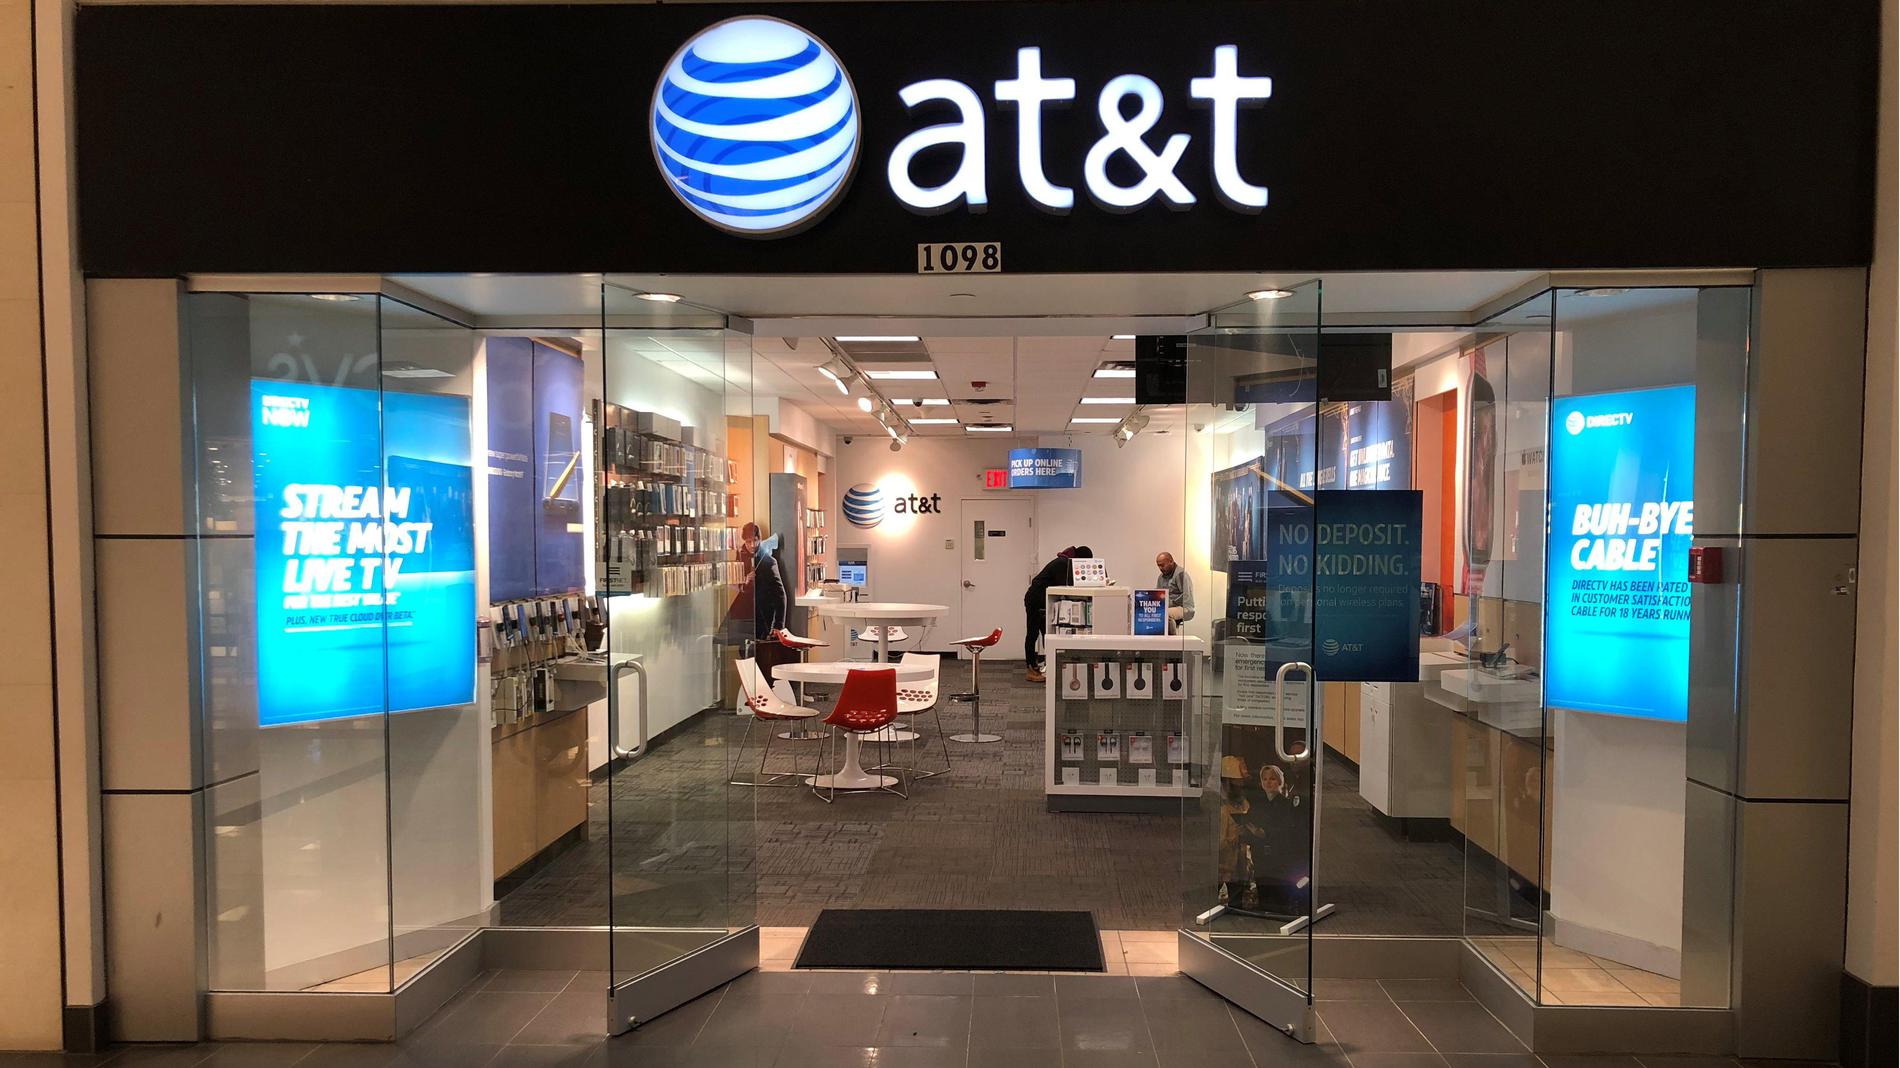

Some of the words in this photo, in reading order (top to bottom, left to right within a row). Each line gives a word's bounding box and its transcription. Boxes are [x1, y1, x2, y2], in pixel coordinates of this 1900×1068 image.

[887, 44, 1272, 210] at&t
[923, 245, 999, 271] 1098
[262, 407, 310, 428] NOW
[1586, 413, 1633, 428] DIRECTV
[1011, 460, 1022, 468] PICK
[1023, 459, 1034, 467] UP
[1034, 459, 1063, 468] ONLINE
[1011, 468, 1034, 477] ORDERS
[1035, 468, 1057, 476] HERE
[986, 469, 1008, 489] EXIT
[280, 483, 411, 518] STREAM
[894, 493, 942, 514] at&t
[281, 521, 345, 556] THE
[347, 521, 433, 555] MOST
[1279, 524, 1309, 545] NO
[1317, 523, 1410, 545] DEPOSIT.
[1571, 538, 1661, 571] CABLE
[283, 558, 355, 593] LIVE
[360, 557, 403, 590] TV
[1279, 554, 1308, 575] NO
[1317, 554, 1409, 576] KIDDING.
[1337, 584, 1367, 595] longer
[1369, 585, 1408, 596] required
[1572, 579, 1608, 591] DIRECTV
[1610, 580, 1628, 591] HAS
[1630, 580, 1655, 592] BEEN
[1657, 581, 1688, 593] RATED
[1571, 593, 1580, 603] IN
[1582, 593, 1629, 605] CUSTOMER
[1571, 606, 1597, 616] CABLE
[1599, 606, 1616, 617] FOR
[1619, 607, 1628, 618] 18
[1632, 608, 1661, 620] YEARS
[1236, 623, 1262, 633] first
[1341, 644, 1363, 652] AT&T
